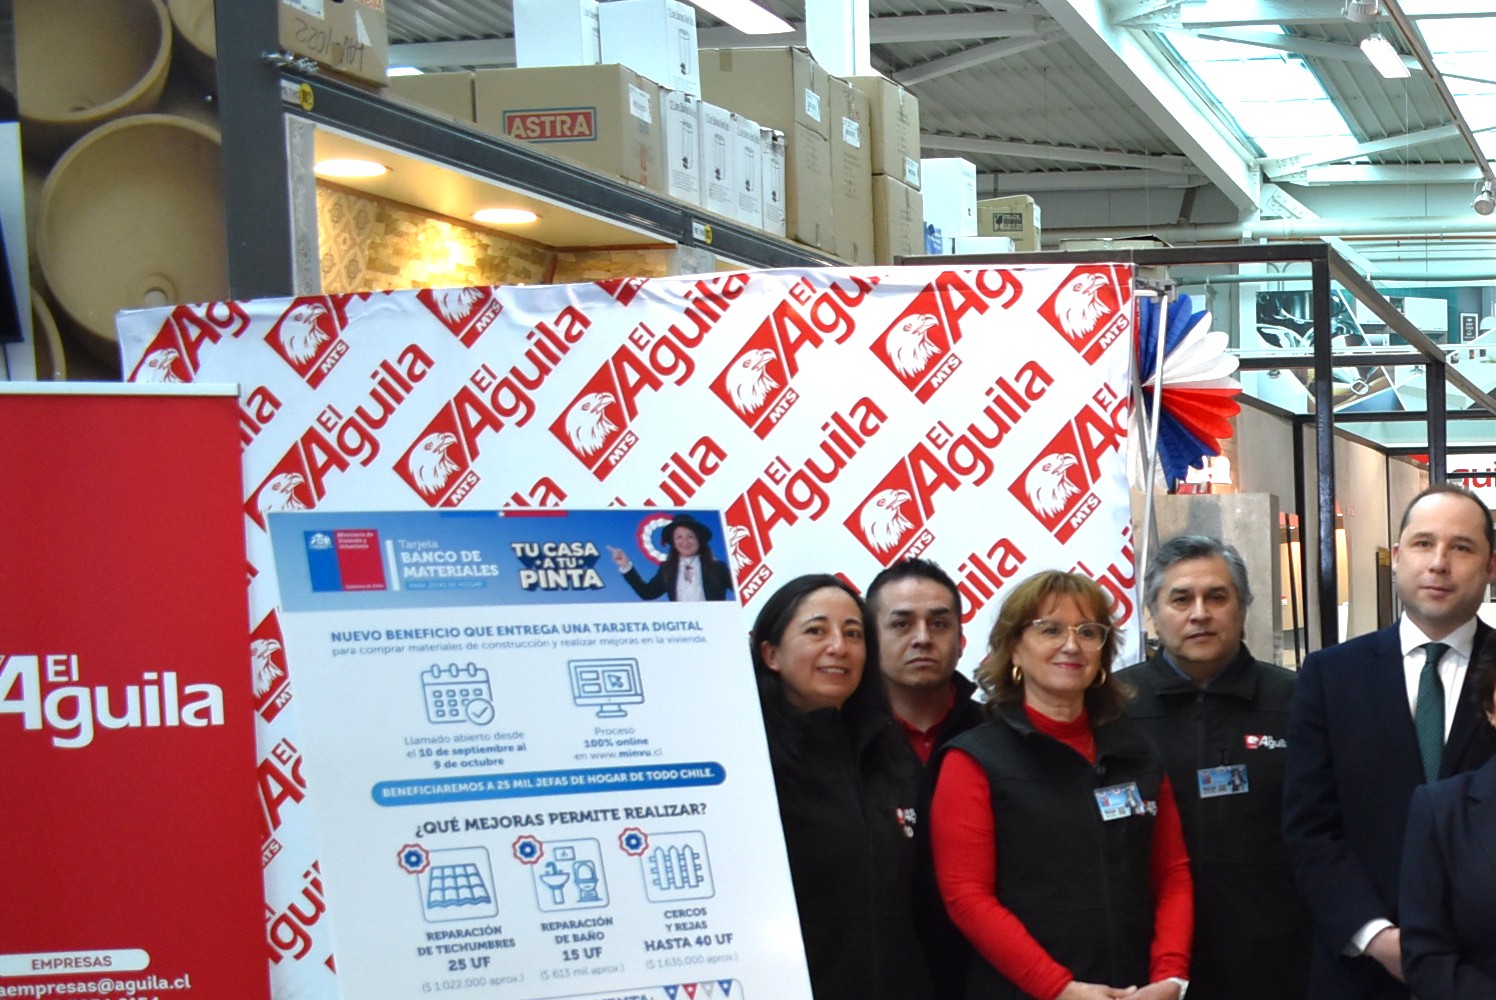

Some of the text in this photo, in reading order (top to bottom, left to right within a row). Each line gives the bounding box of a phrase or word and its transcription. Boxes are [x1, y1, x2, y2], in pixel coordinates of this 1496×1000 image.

[511, 115, 591, 139] ASTRA
[633, 321, 656, 352] El
[1101, 314, 1129, 350] MTS
[613, 273, 750, 422] Aguila
[455, 305, 593, 462] Aguila
[470, 363, 497, 393] El
[299, 343, 436, 500] Aguila
[318, 404, 344, 434] El
[908, 360, 1054, 519] Aguila
[926, 420, 953, 451] El
[748, 396, 888, 553] Aguila
[765, 456, 792, 486] El
[451, 470, 478, 506] MTS
[399, 539, 439, 551] Tarjeta
[511, 542, 599, 557] TU CASA
[402, 551, 482, 563] BANCO DE
[541, 557, 576, 568] A TU
[403, 564, 499, 577] MATERIALES
[519, 569, 605, 589] PINTA
[330, 620, 704, 643] NUEVO BENEFICIO QUE ENTREGA UNA TARJETA DIGITAL
[46, 654, 78, 682] El
[0, 655, 225, 748] Aguila
[406, 742, 528, 758] el 10 de septiembre al
[584, 737, 649, 749] 100% online
[433, 757, 505, 770] 9 de octubre
[382, 767, 715, 798] BENEFICIAREMOS A 25 MIL JEFAS DE HOGAR DE TODO CHILE.
[415, 802, 707, 839] ¿QUÉ MEJORAS PERMITE REALIZAR?
[663, 907, 708, 920] CERCOS
[425, 924, 503, 942] REPARACIÓN
[540, 916, 614, 932] REPARACIÓN
[664, 920, 708, 933] Y REJAS
[416, 938, 516, 957] DE TECHUMBRES
[554, 930, 605, 945] DE BAÑO
[643, 932, 733, 952] HASTA 40 UF
[31, 956, 112, 970] EMPRESAS
[448, 956, 491, 972] 25 UF
[562, 946, 603, 962] 15 UF
